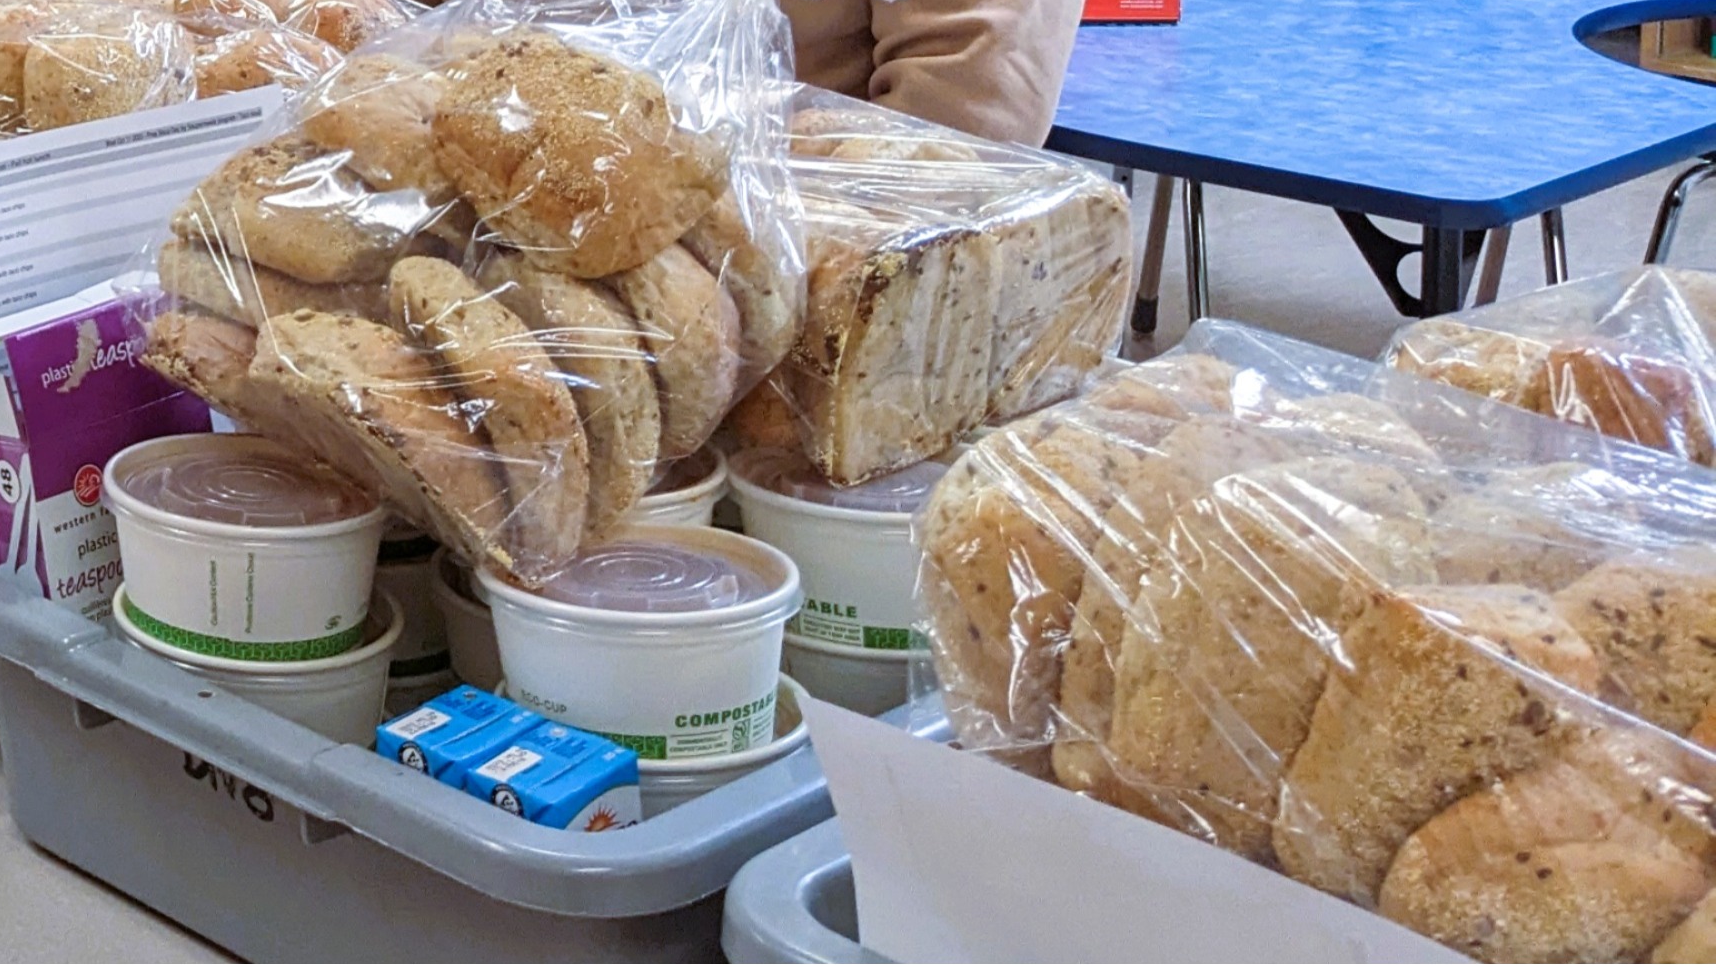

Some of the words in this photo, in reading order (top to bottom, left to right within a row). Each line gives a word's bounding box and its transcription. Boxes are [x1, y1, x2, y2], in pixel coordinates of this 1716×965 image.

[0, 467, 13, 497] 48
[53, 511, 97, 534] western
[77, 530, 118, 560] plastic
